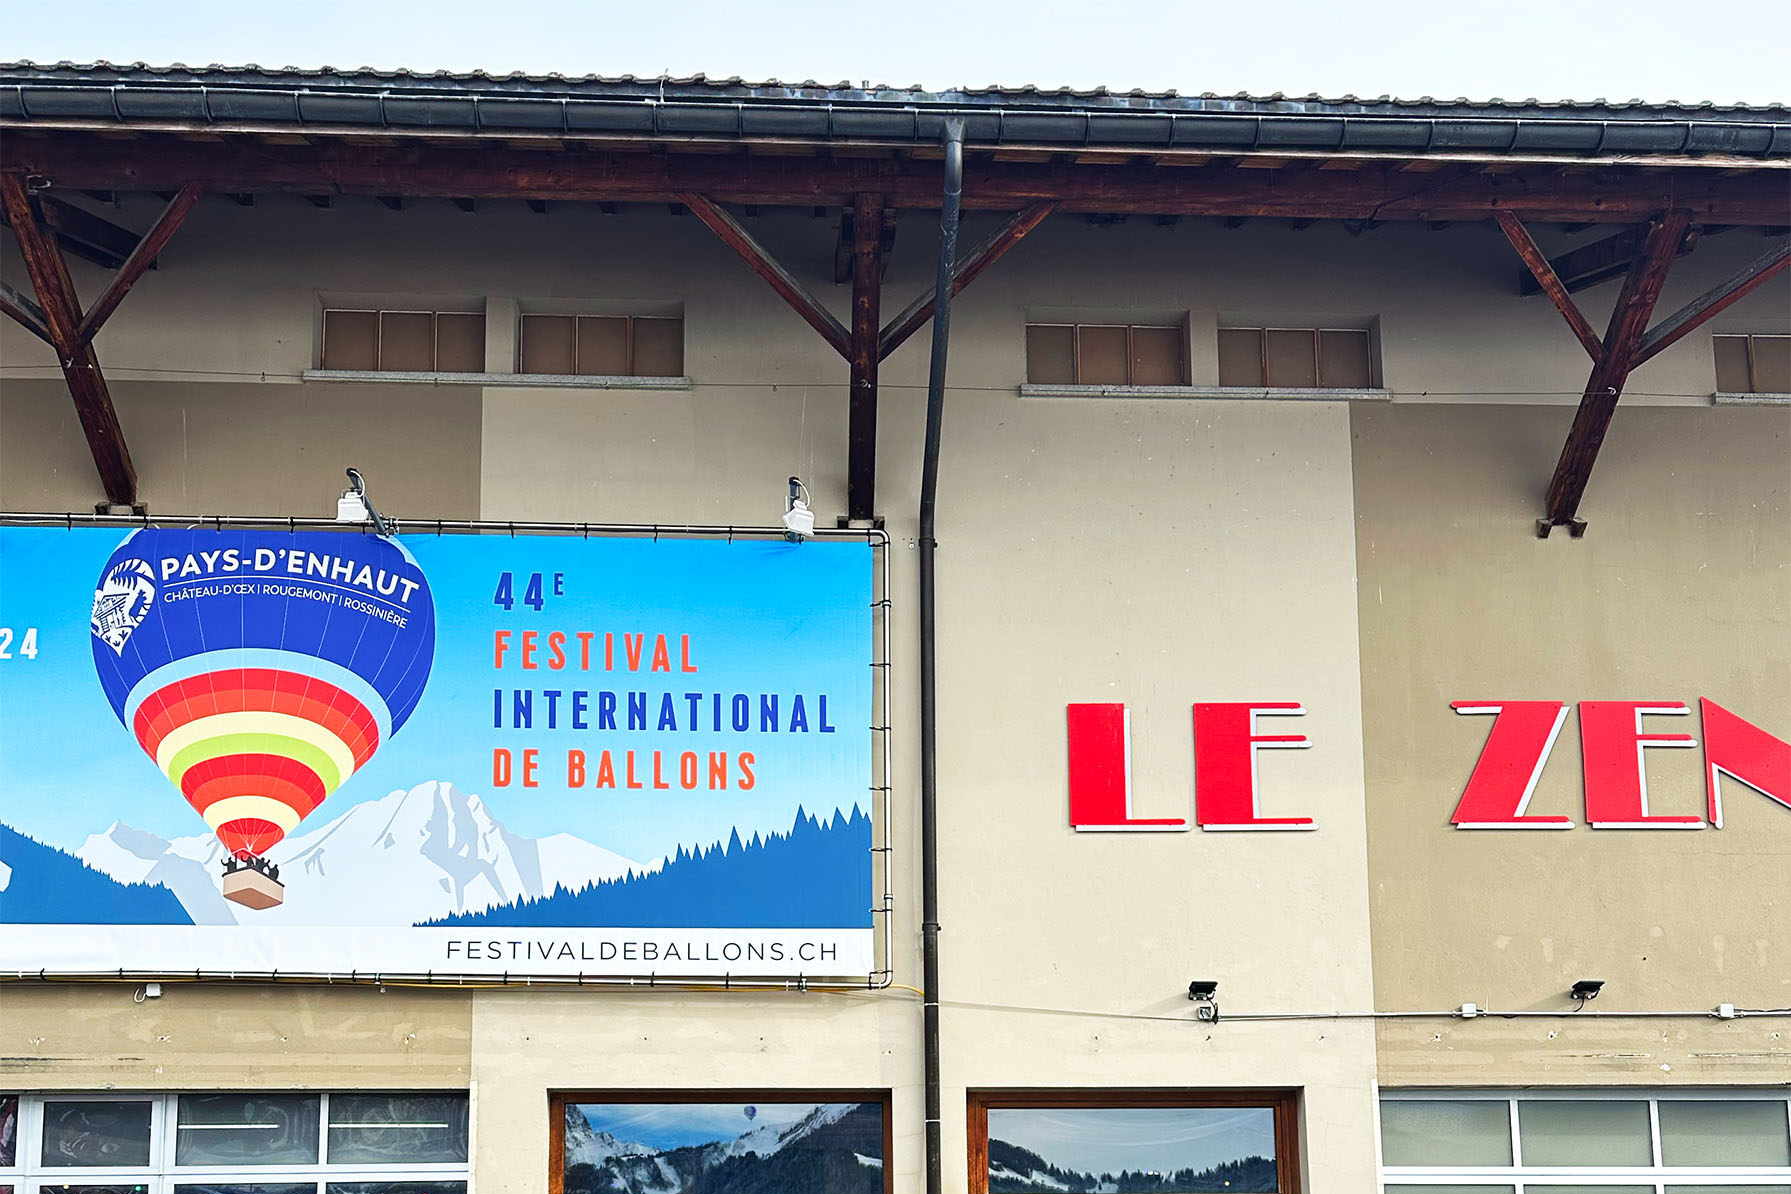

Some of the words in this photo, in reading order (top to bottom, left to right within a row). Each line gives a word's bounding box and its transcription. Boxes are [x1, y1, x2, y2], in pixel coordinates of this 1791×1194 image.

[161, 548, 419, 604] PAYS-D'ENHAUT
[262, 584, 339, 605] ROUGEMONT
[343, 597, 409, 629] ROSSINIÈRE
[494, 630, 698, 673] FESTIVAL
[493, 689, 836, 733] INTERNATIONAL
[493, 748, 539, 788] DE
[567, 749, 756, 790] BALLONS
[1068, 702, 1319, 832] LE
[447, 940, 837, 961] FESTIVALDEBALLONS.CH
